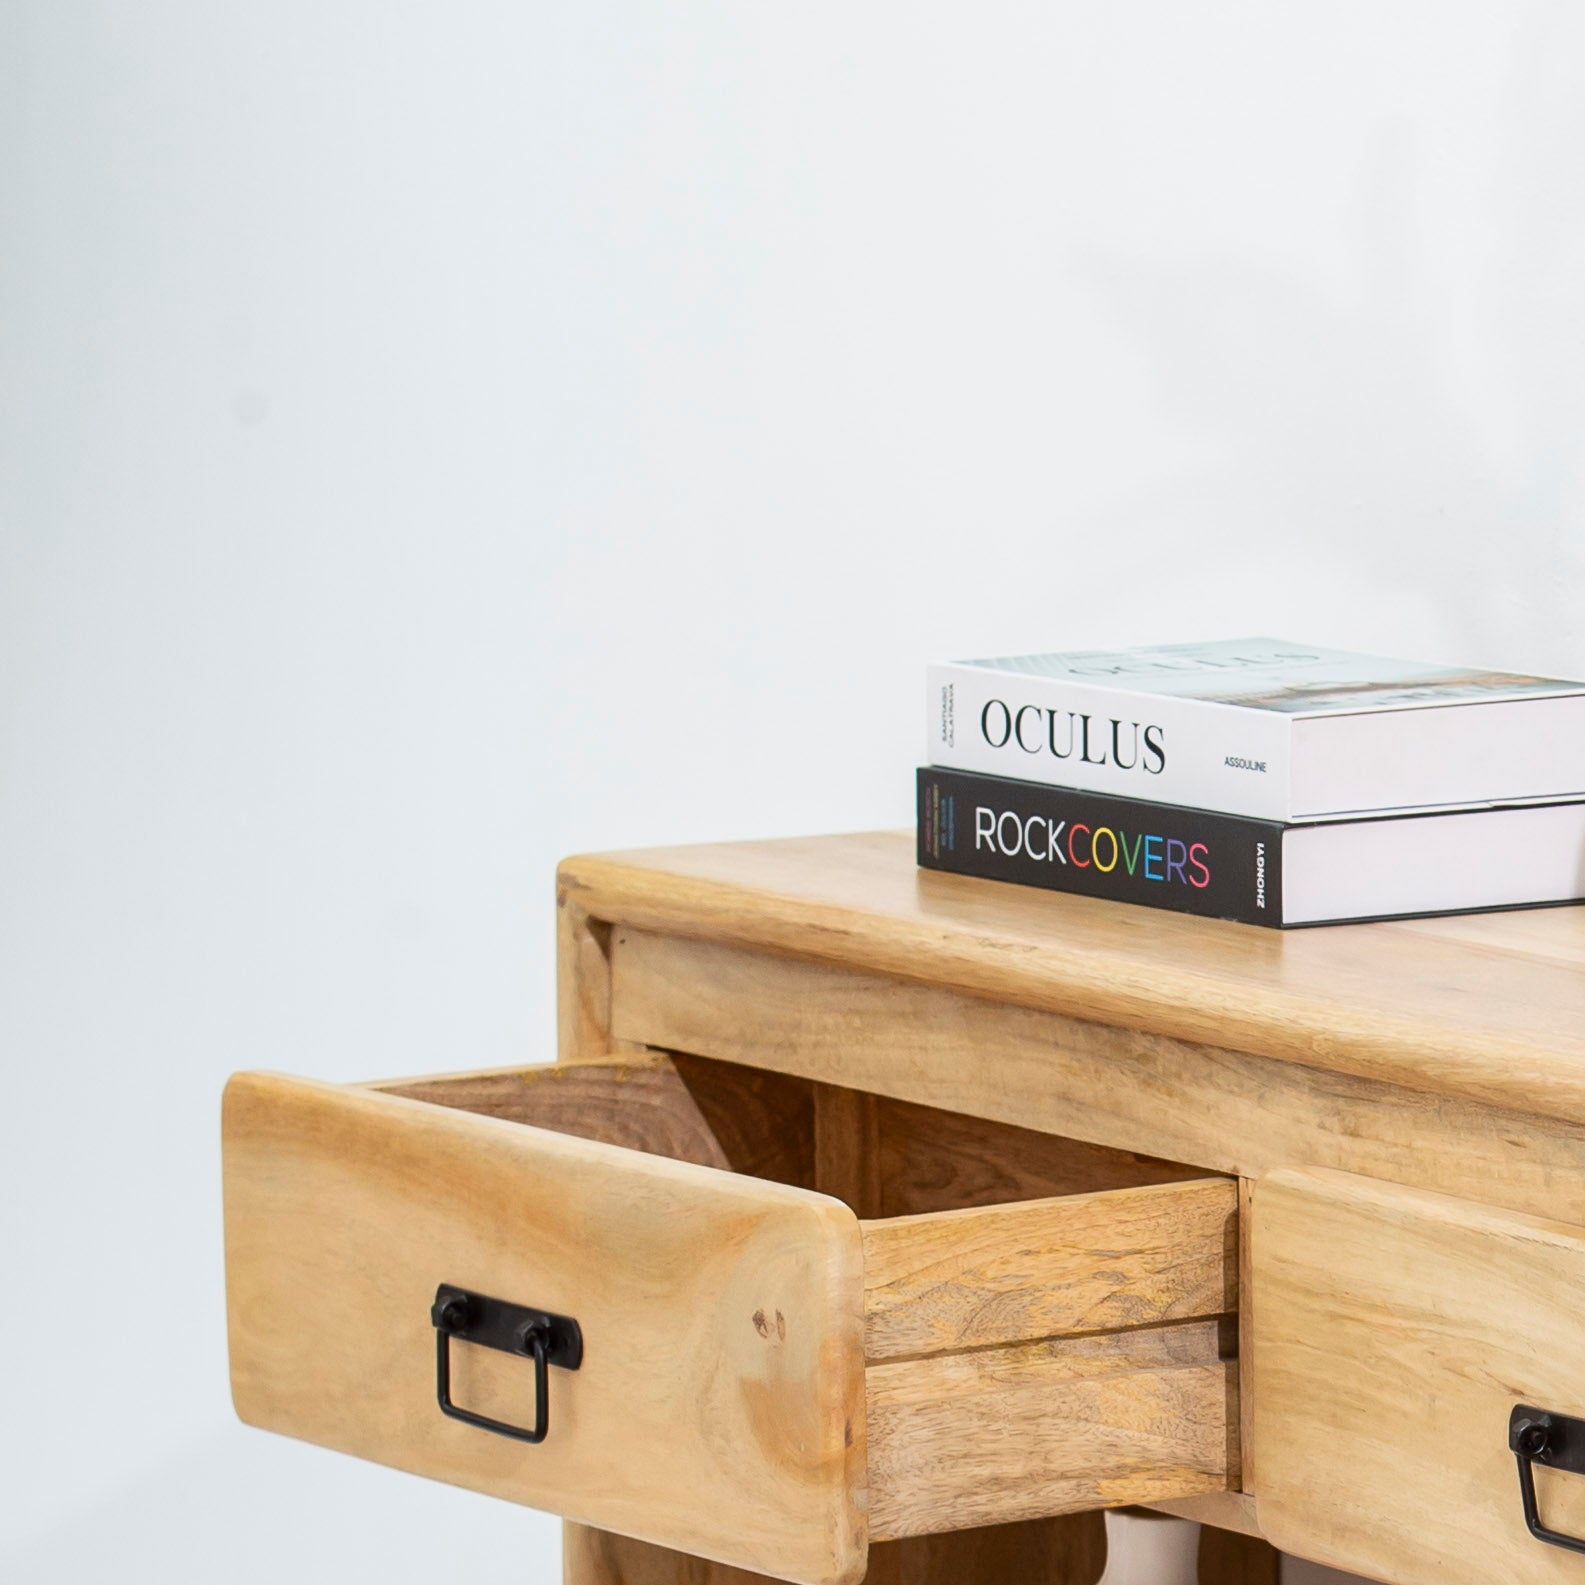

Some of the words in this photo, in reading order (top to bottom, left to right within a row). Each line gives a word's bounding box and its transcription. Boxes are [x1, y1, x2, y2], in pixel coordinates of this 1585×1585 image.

[980, 698, 1166, 775] OCULUS
[1224, 756, 1267, 773] ASSOULINE
[1256, 842, 1266, 909] ZHONGYI
